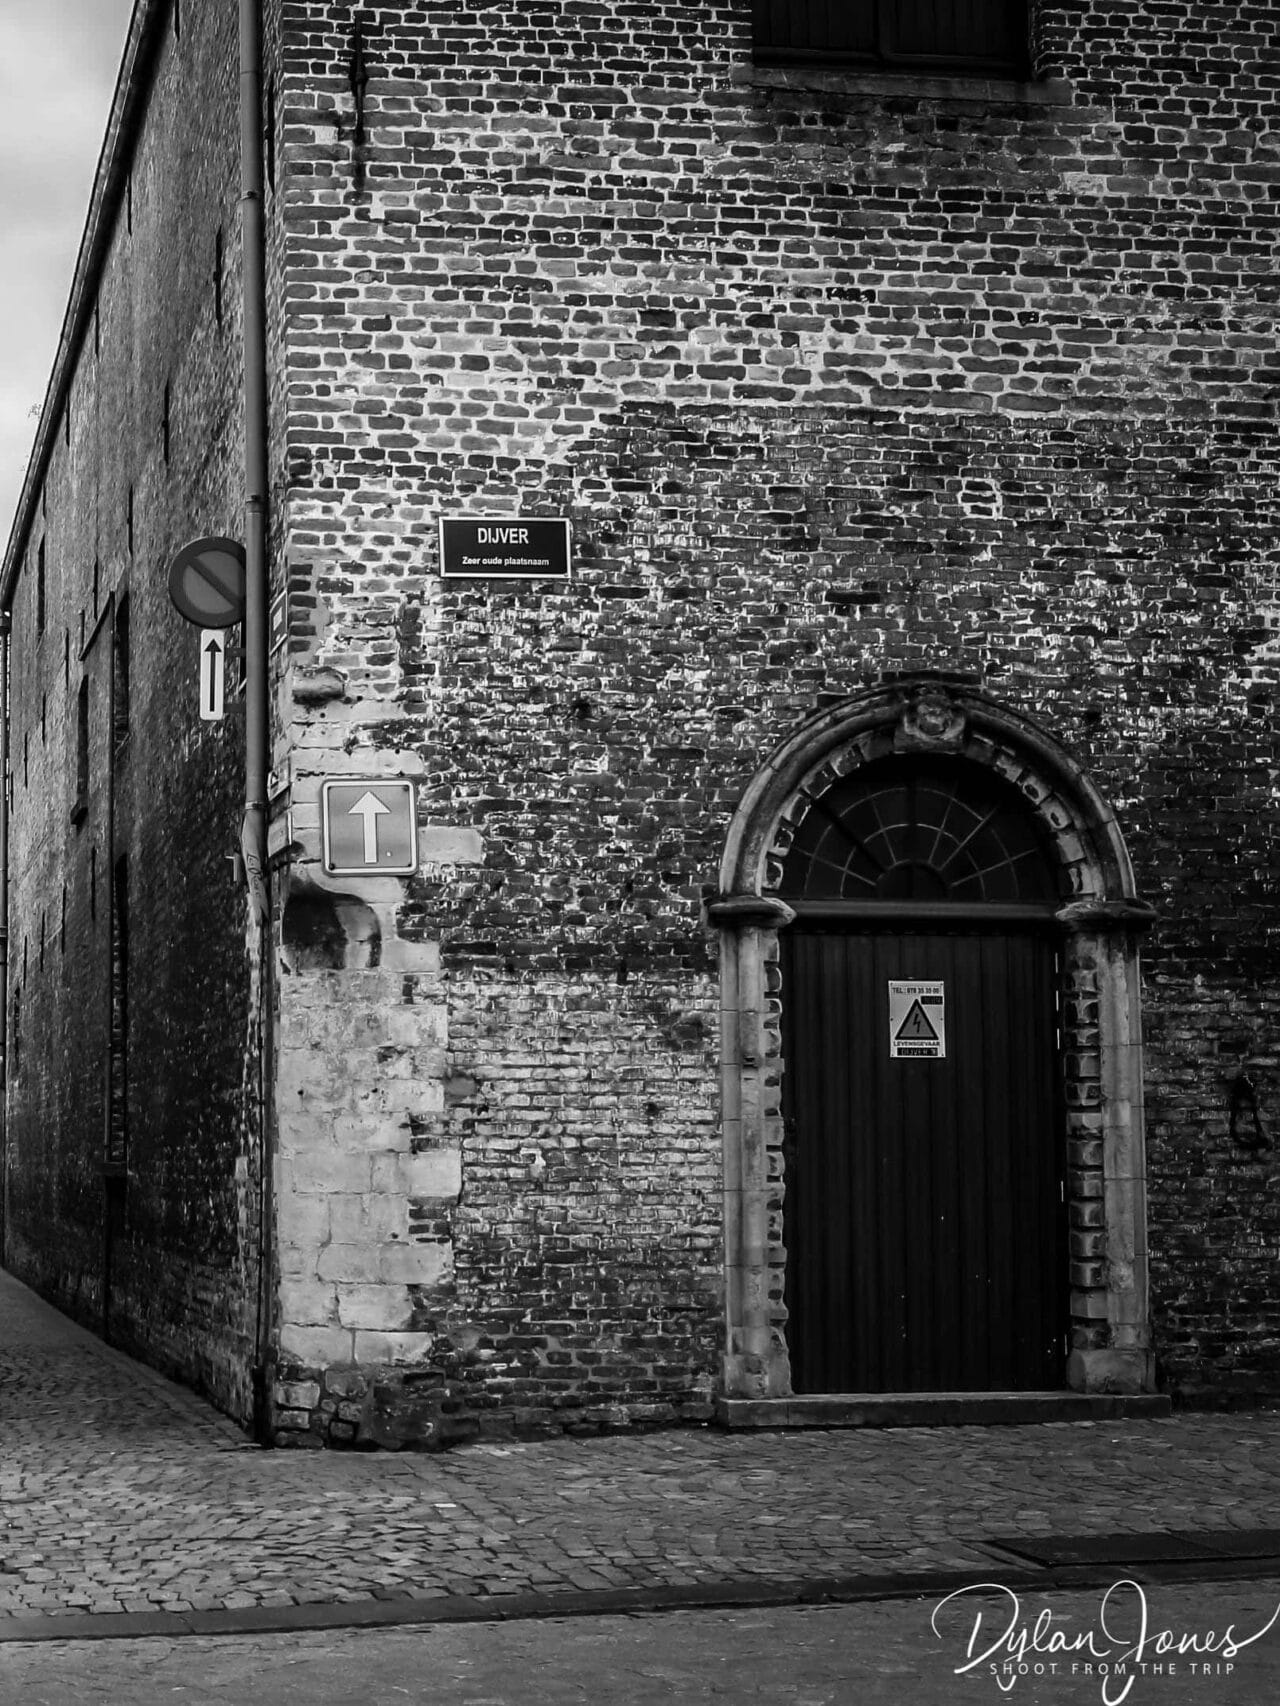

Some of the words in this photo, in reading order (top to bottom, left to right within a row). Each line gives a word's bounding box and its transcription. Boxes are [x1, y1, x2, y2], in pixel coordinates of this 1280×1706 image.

[477, 527, 529, 544] DIJVER
[461, 556, 480, 565] Zeer
[482, 556, 502, 565] oude
[504, 556, 550, 567] plaatsnaam
